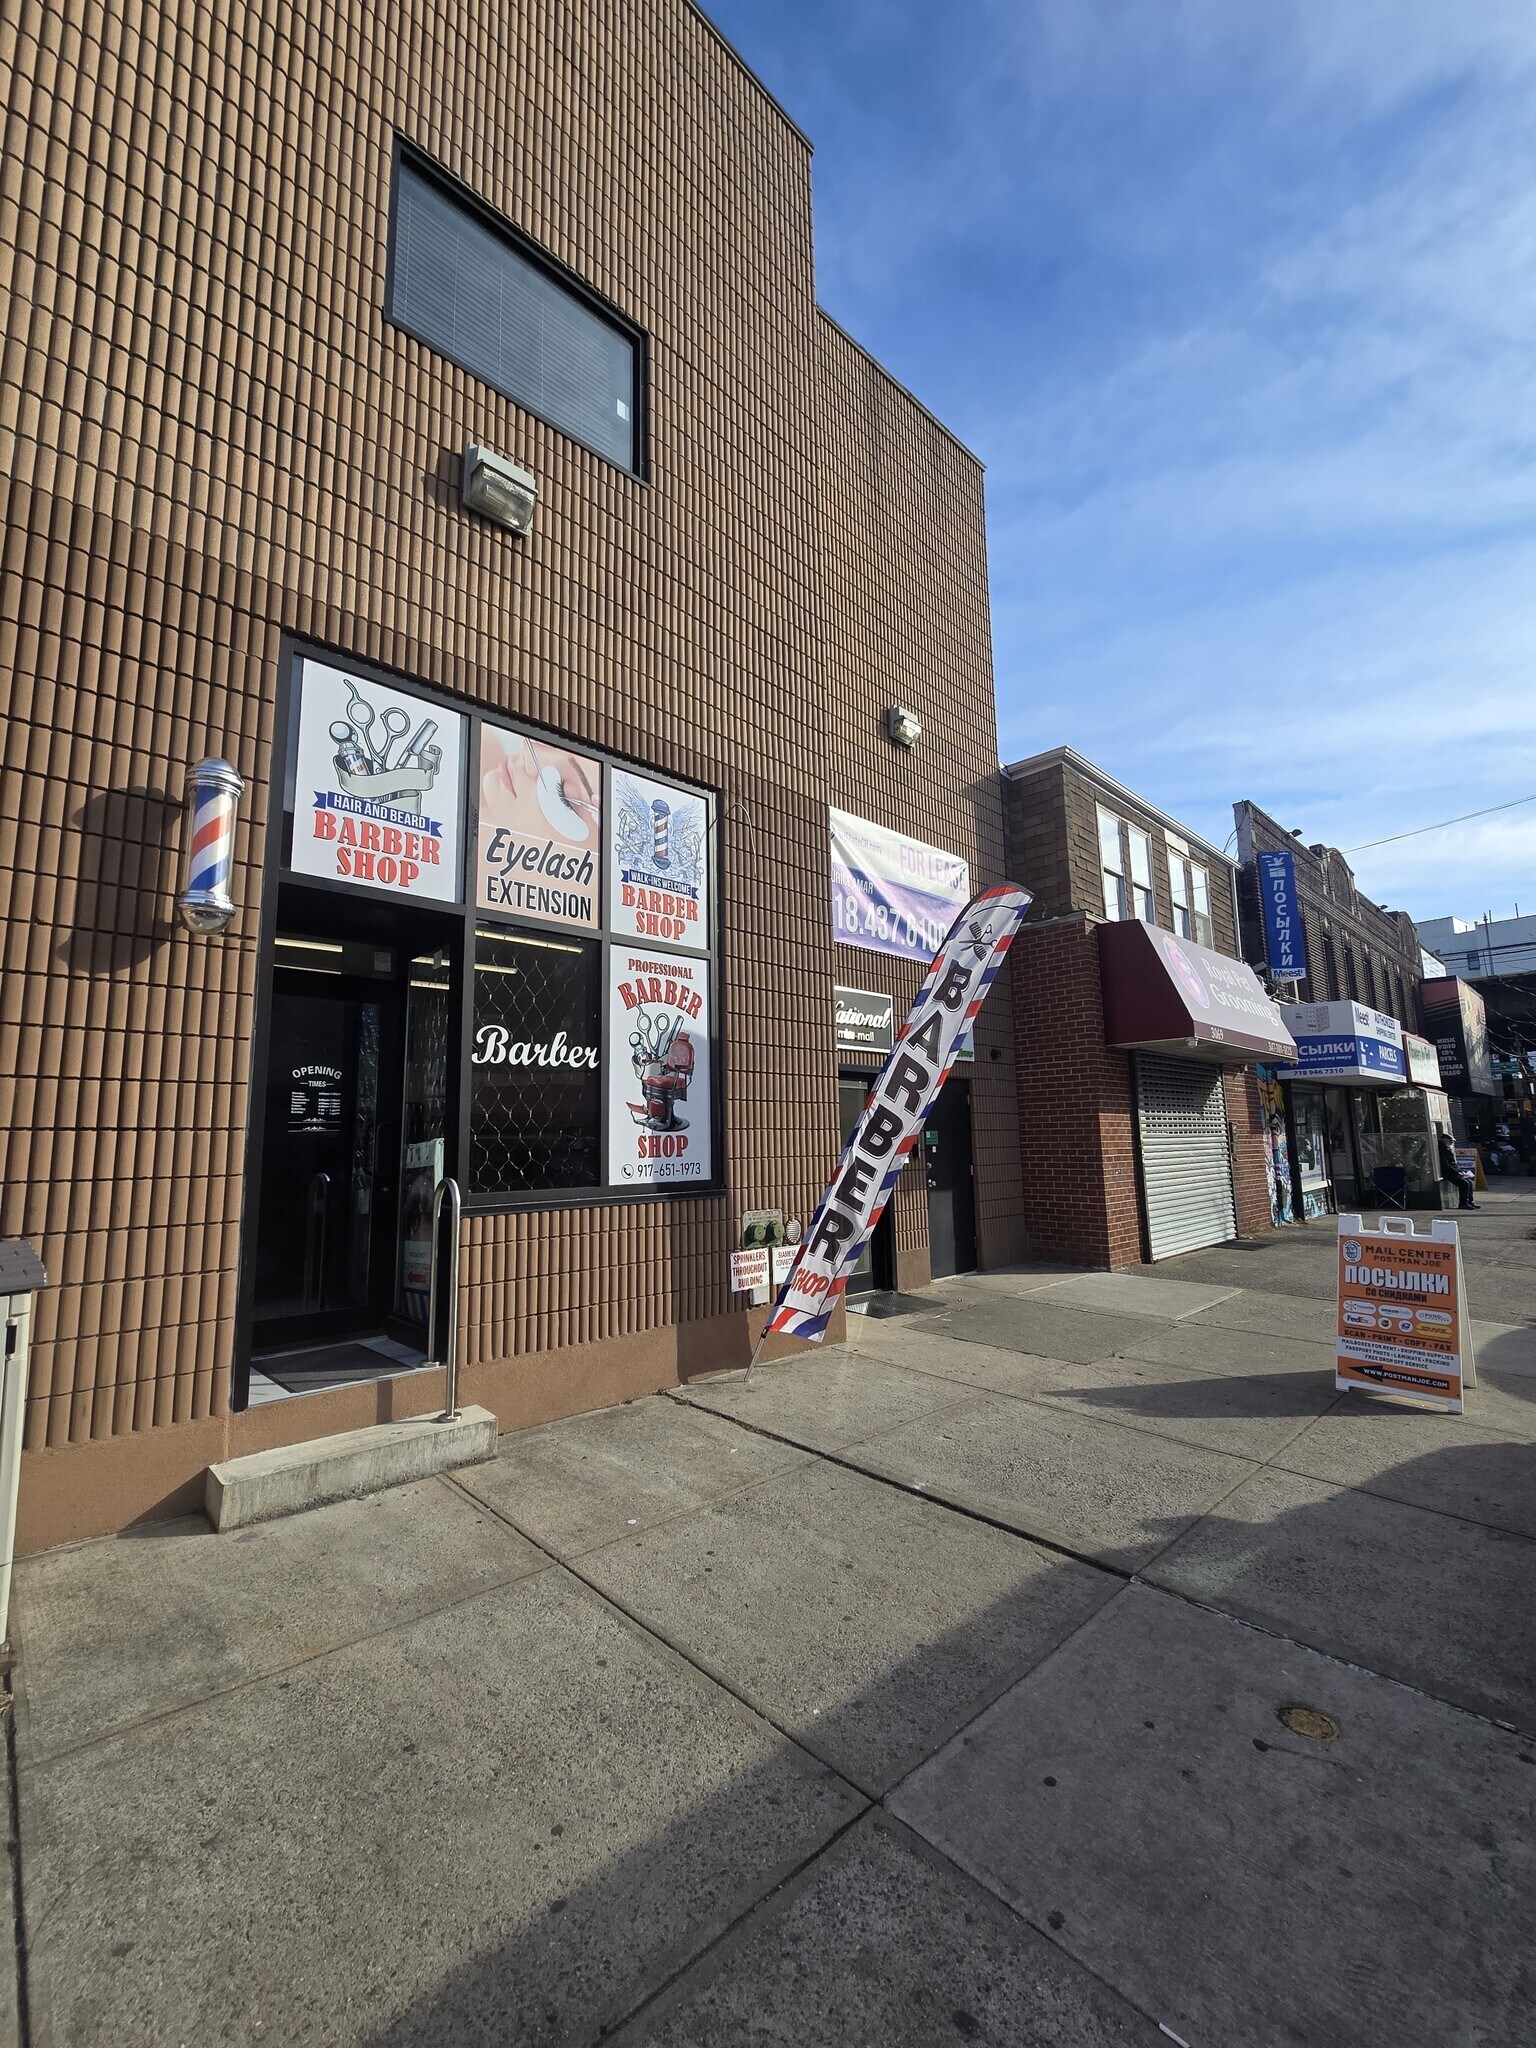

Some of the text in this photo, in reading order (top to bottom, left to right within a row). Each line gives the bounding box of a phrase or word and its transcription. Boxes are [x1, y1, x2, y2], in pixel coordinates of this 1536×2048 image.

[334, 795, 425, 829] HAIR AND BEARD
[313, 810, 440, 865] BARBER
[336, 846, 419, 887] SHOP
[486, 828, 594, 886] Eyelash
[899, 843, 925, 877] FOR
[630, 870, 691, 895] WALK-INS WELCOME
[487, 876, 591, 921] EXTENSION
[622, 884, 698, 921] BARBER
[636, 911, 686, 940] SHOP
[1273, 880, 1293, 966] ПОСЫЛКИ
[628, 958, 693, 979] PROFESSIONAL
[1201, 958, 1234, 988] Royal
[1273, 969, 1301, 978] Meest
[617, 977, 703, 1019] BARBER
[1210, 983, 1279, 1026] Grooming
[836, 1000, 891, 1029] ational
[471, 1024, 600, 1069] Barber
[1299, 1042, 1355, 1056] СЫЛКИ
[1378, 1045, 1397, 1062] PARCELS
[292, 1066, 342, 1080] OPENING
[809, 959, 970, 1266] BARBER
[637, 1134, 689, 1159] SHOP
[637, 1162, 701, 1178] 917-651-1973
[733, 1251, 766, 1265] SPRINKLERS
[776, 1257, 794, 1266] CONNECT
[1365, 1245, 1396, 1256] MAIL
[1399, 1248, 1450, 1260] CENTER
[1374, 1255, 1420, 1265] POSTMAN
[733, 1262, 768, 1277] THROUGHOUT
[1344, 1264, 1450, 1295] ПОСЫЛКИ
[738, 1275, 763, 1288] BUILDING
[791, 1267, 830, 1298] SHOP
[1365, 1287, 1428, 1303] СО СКИДКАМИ
[1347, 1315, 1369, 1324] FedEx
[1342, 1339, 1371, 1348] MAILBOXES
[1400, 1348, 1426, 1356] SHIPPING
[1427, 1352, 1454, 1361] SUPPLIES
[1344, 1330, 1452, 1352] SCAN PRINT COPY FAX
[1345, 1345, 1372, 1353] PASSPORT
[1393, 1353, 1422, 1362] LAMINATE
[1426, 1358, 1450, 1366] PACKING
[1405, 1361, 1428, 1369] SERVICE
[1364, 1368, 1448, 1388] WWW.POSTMANJOE.COM
